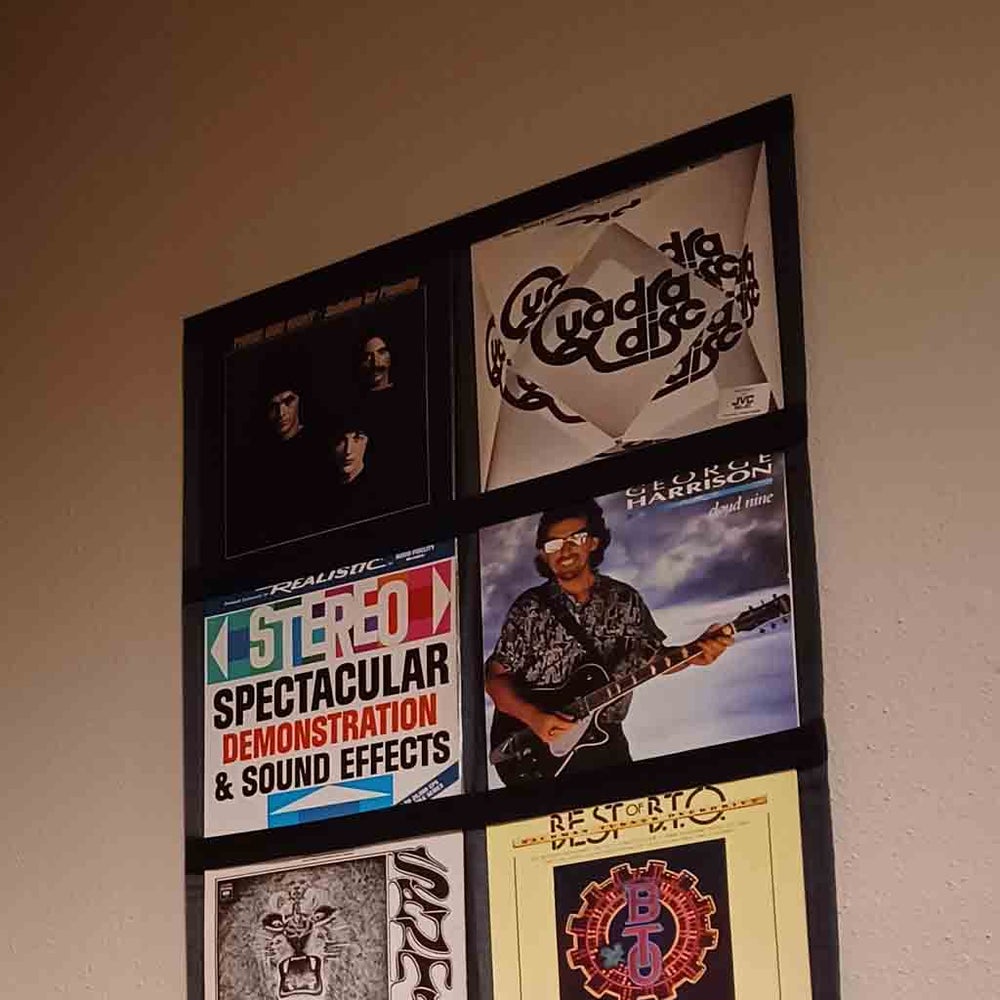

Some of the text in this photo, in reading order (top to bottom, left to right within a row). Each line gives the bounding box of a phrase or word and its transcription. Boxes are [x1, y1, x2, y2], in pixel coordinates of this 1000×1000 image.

[626, 463, 773, 511] HARRISON
[745, 492, 775, 509] nine
[256, 557, 390, 597] REALISTIC
[250, 577, 410, 669] STEREO
[213, 641, 449, 730] SPECTACULAR
[222, 692, 438, 765] DEMONSTRATION
[215, 730, 451, 801] & SOUND EFFECTS
